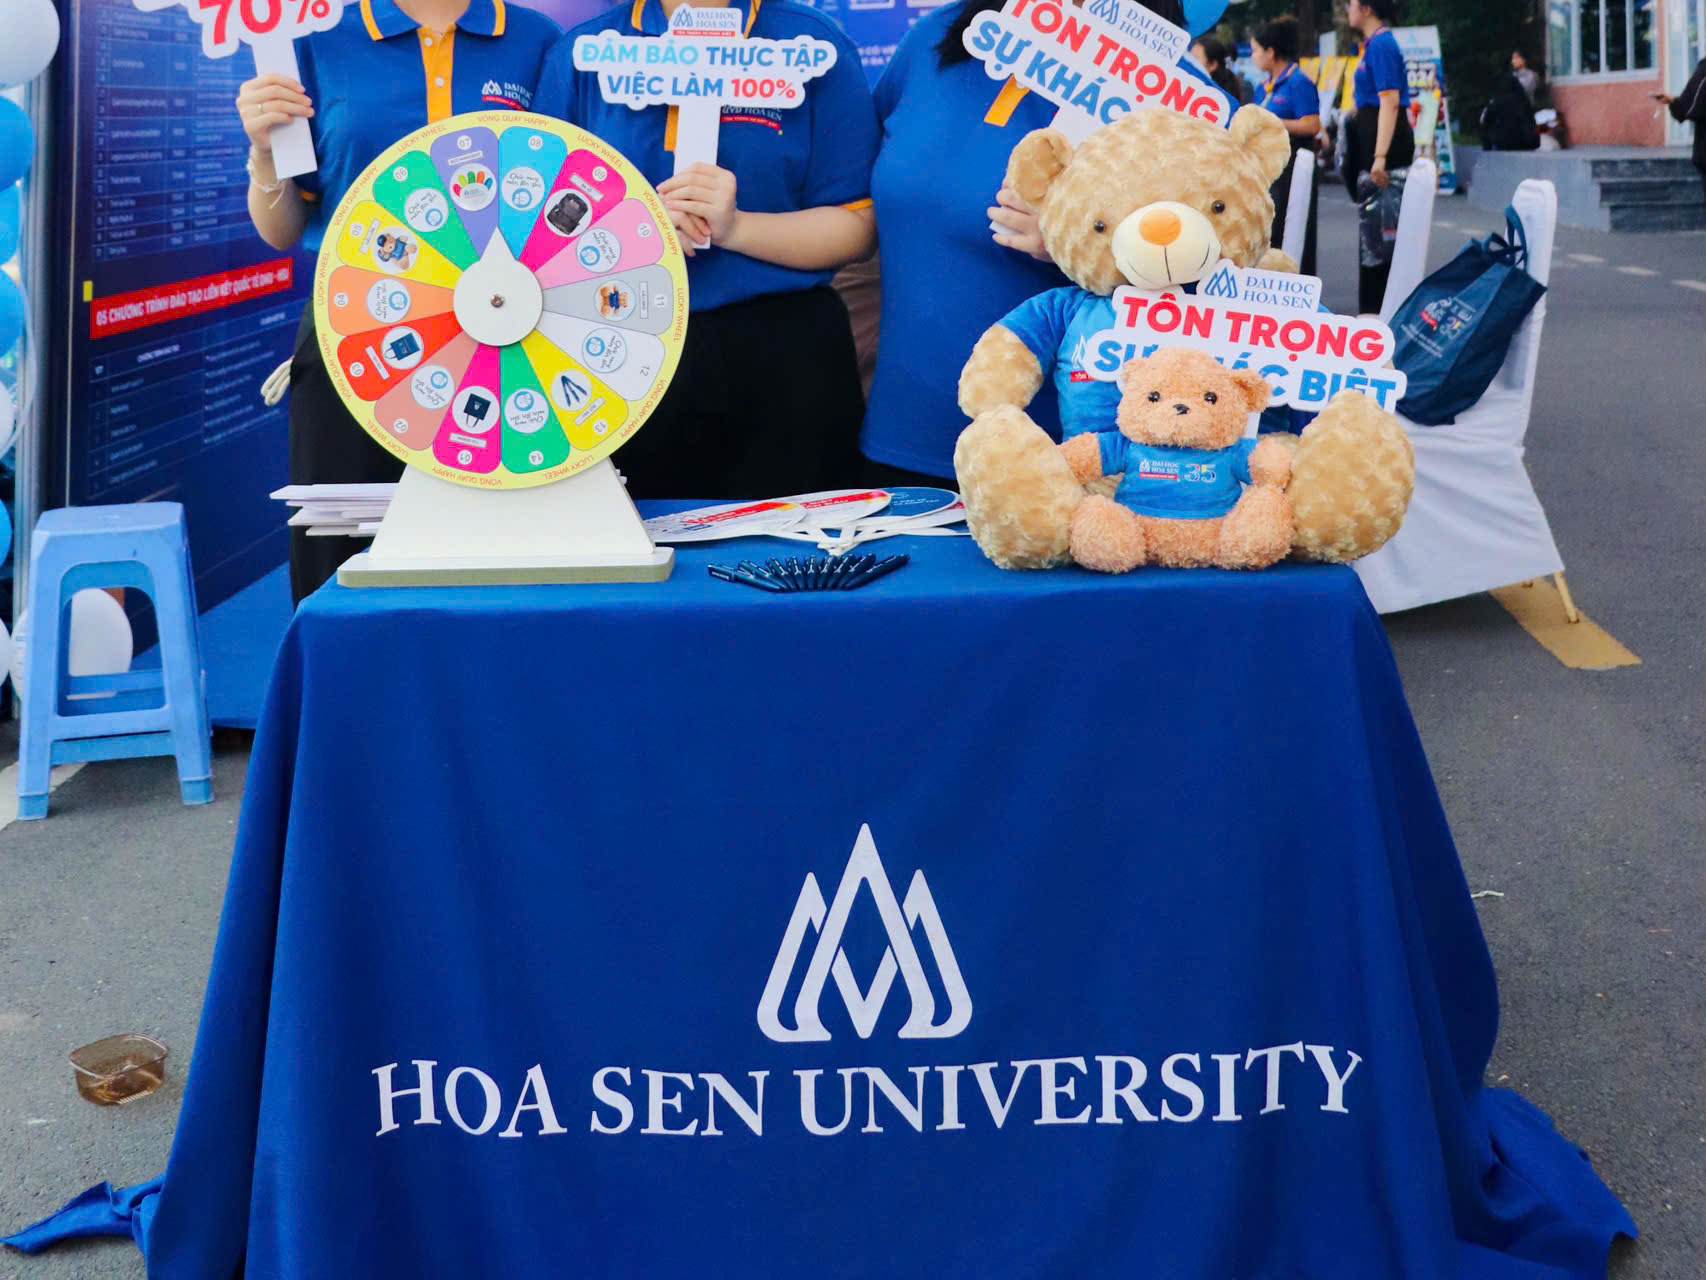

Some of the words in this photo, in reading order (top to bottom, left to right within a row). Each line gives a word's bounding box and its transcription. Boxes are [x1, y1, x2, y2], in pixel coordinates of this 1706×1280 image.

[581, 38, 638, 64] ĐẢM
[645, 38, 699, 65] BẢO
[706, 46, 774, 72] THỰC
[781, 43, 828, 73] TẬP
[1120, 20, 1149, 45] HOA
[1150, 39, 1177, 61] SEN
[607, 71, 664, 100] VIỆC
[671, 72, 723, 97] LÀM
[731, 78, 796, 99] 100%
[972, 20, 1032, 71] SỰ
[1024, 50, 1132, 125] KHÁC
[1092, 34, 1220, 124] TRỌNG
[95, 310, 108, 326] 05
[109, 301, 144, 323] CHƯƠNG
[1243, 290, 1278, 305] HOA
[1282, 295, 1313, 309] SEN
[1122, 293, 1215, 338] TÔN
[1224, 311, 1385, 363] TRỌNG
[1184, 464, 1217, 483] 35
[371, 1059, 568, 1138] HOA
[590, 1065, 769, 1138] SEN
[792, 1040, 1363, 1138] UNIVERSITY
